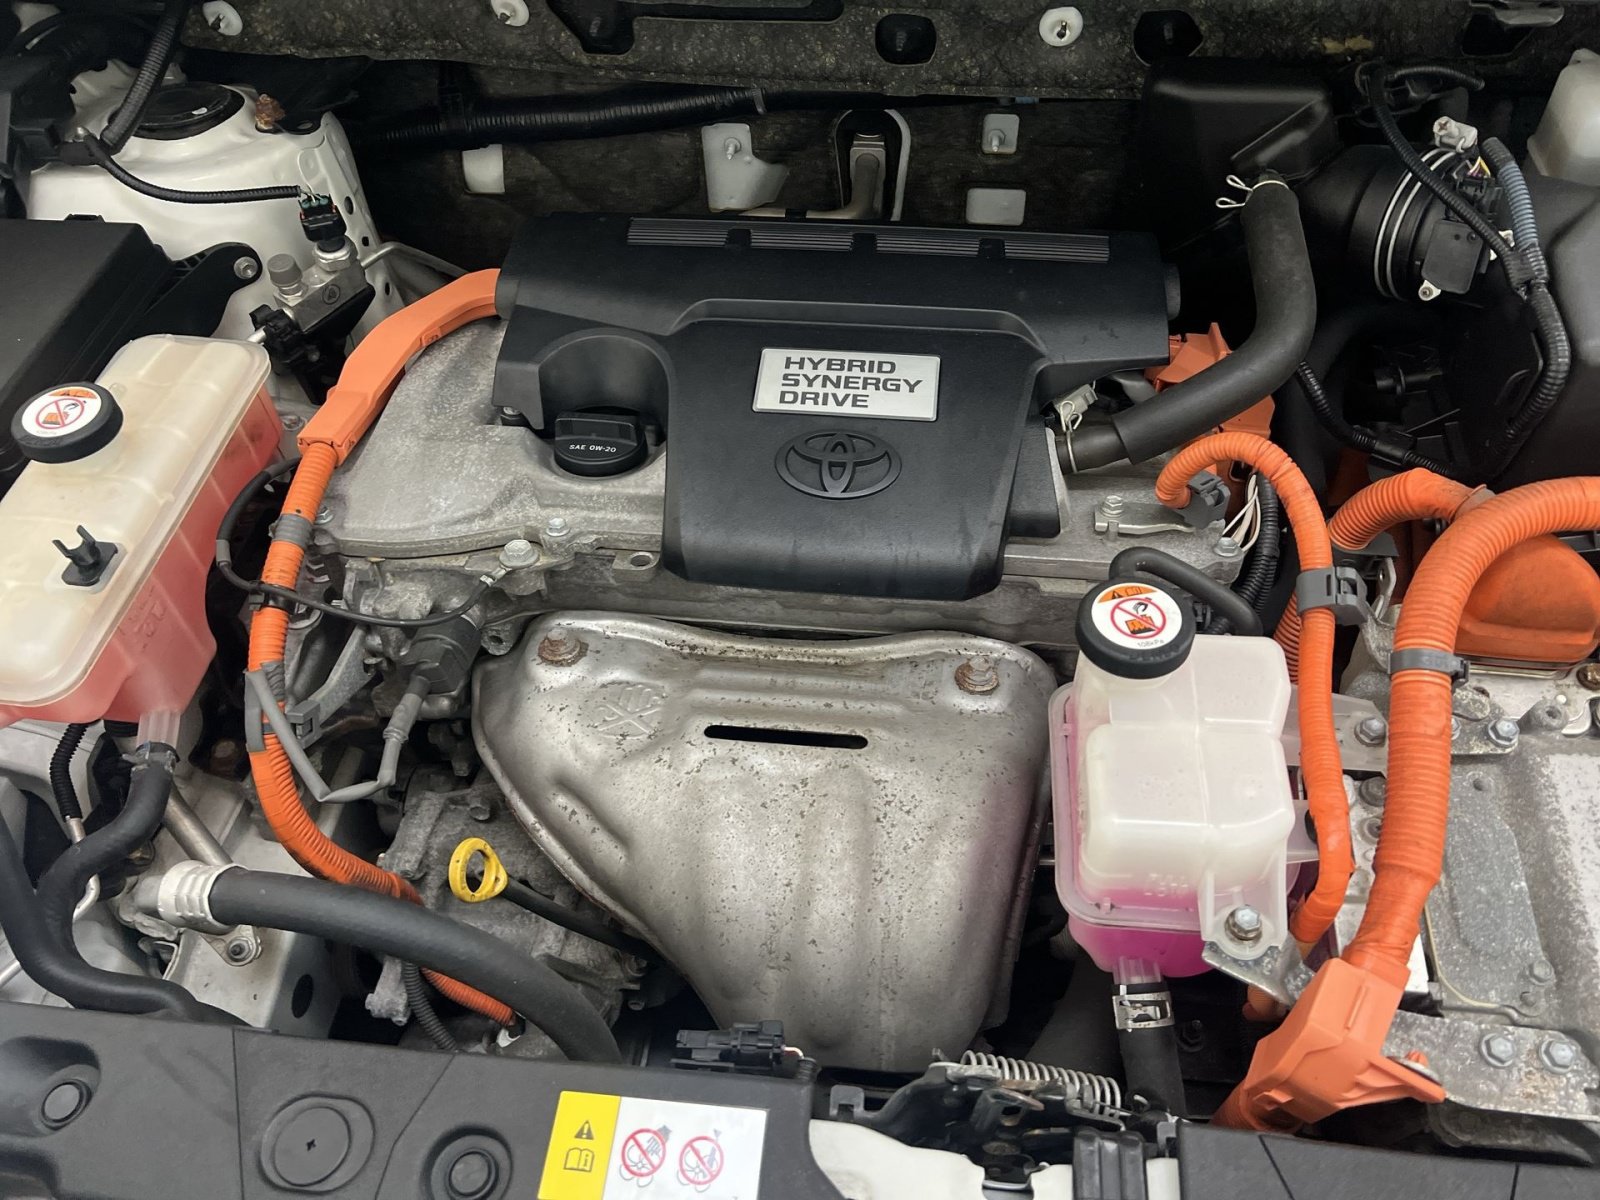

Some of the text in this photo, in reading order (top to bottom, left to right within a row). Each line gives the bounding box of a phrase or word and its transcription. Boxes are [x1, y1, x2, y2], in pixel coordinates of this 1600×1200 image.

[784, 357, 896, 374] HYBRID
[781, 374, 923, 393] SYNERGY
[779, 391, 870, 408] DRIVE
[589, 445, 617, 453] 0W-20
